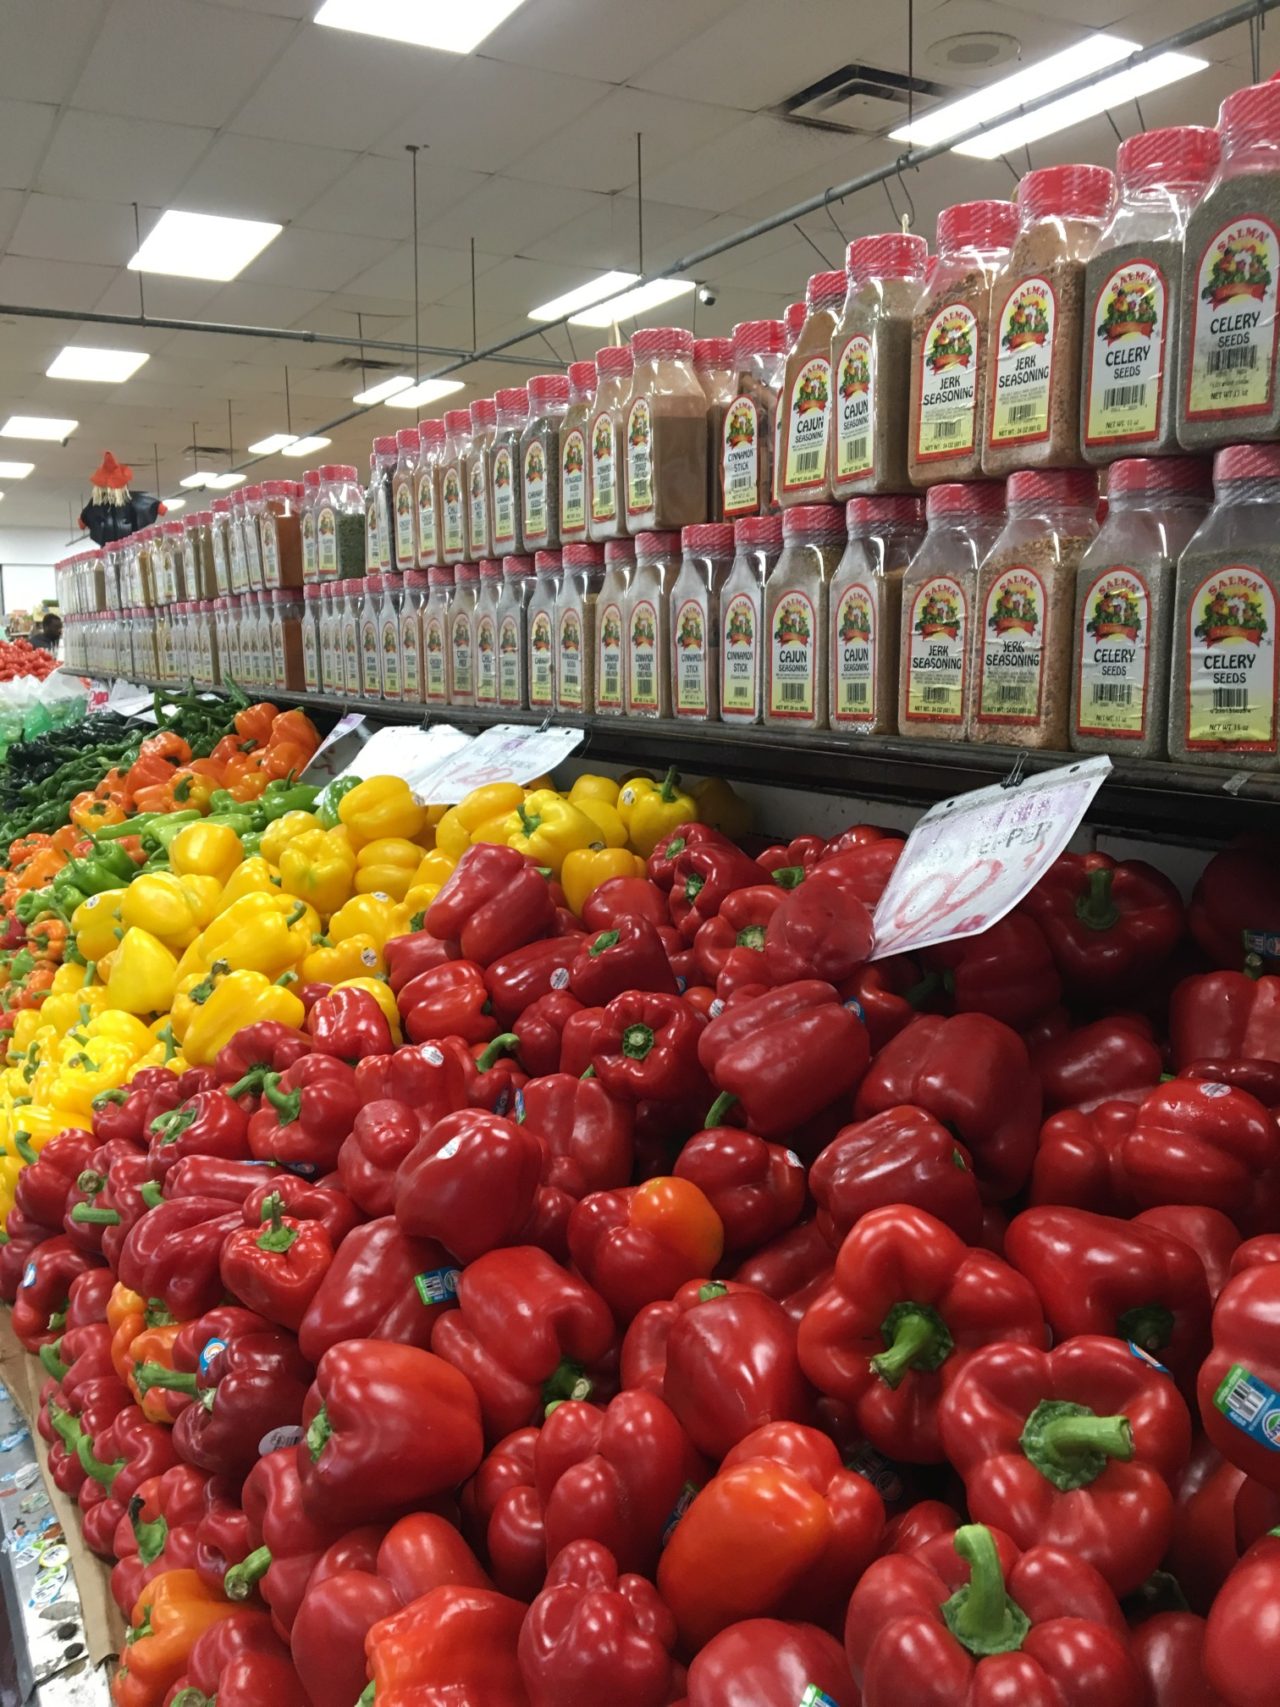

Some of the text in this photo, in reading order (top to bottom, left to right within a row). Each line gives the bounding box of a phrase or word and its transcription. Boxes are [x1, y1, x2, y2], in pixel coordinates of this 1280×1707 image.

[1217, 226, 1266, 253] SALMA
[1111, 270, 1154, 293] SALMA
[1012, 286, 1046, 306] SALMA
[936, 311, 969, 330] SALMA
[1210, 312, 1261, 334] CELERY
[1218, 332, 1250, 348] SEEDS
[1015, 355, 1036, 371] JERK
[1105, 345, 1151, 366] CELERY
[998, 366, 1049, 388] SEASONING
[1113, 364, 1141, 379] SEEDS
[939, 375, 961, 390] JERK
[923, 386, 974, 405] SEASONING
[844, 399, 869, 419] CAJUN
[796, 416, 824, 433] CAJUN
[843, 414, 869, 431] SEASONING
[795, 430, 823, 443] SEASONING
[728, 448, 754, 462] CINNAMON
[733, 462, 749, 473] STICK
[925, 583, 957, 598] SALMA
[1000, 575, 1035, 591] SALMA
[1098, 577, 1136, 595] SALMA
[1208, 576, 1259, 596] SALMA
[928, 645, 949, 657] JERK
[1003, 641, 1025, 653] JERK
[727, 651, 753, 661] CINNAMON
[779, 650, 807, 663] CAJUN
[844, 648, 869, 662] CAJUN
[986, 653, 1039, 667] SEASONING
[1093, 648, 1136, 664] CELERY
[1204, 654, 1256, 669] CELERY
[686, 665, 699, 673] STICK
[733, 663, 748, 673] STICK
[778, 663, 808, 673] SEASONING
[843, 662, 869, 672] SEASONING
[912, 657, 962, 670] SEASONING
[1102, 666, 1127, 676] SEEDS
[1213, 672, 1246, 684] SEEDS
